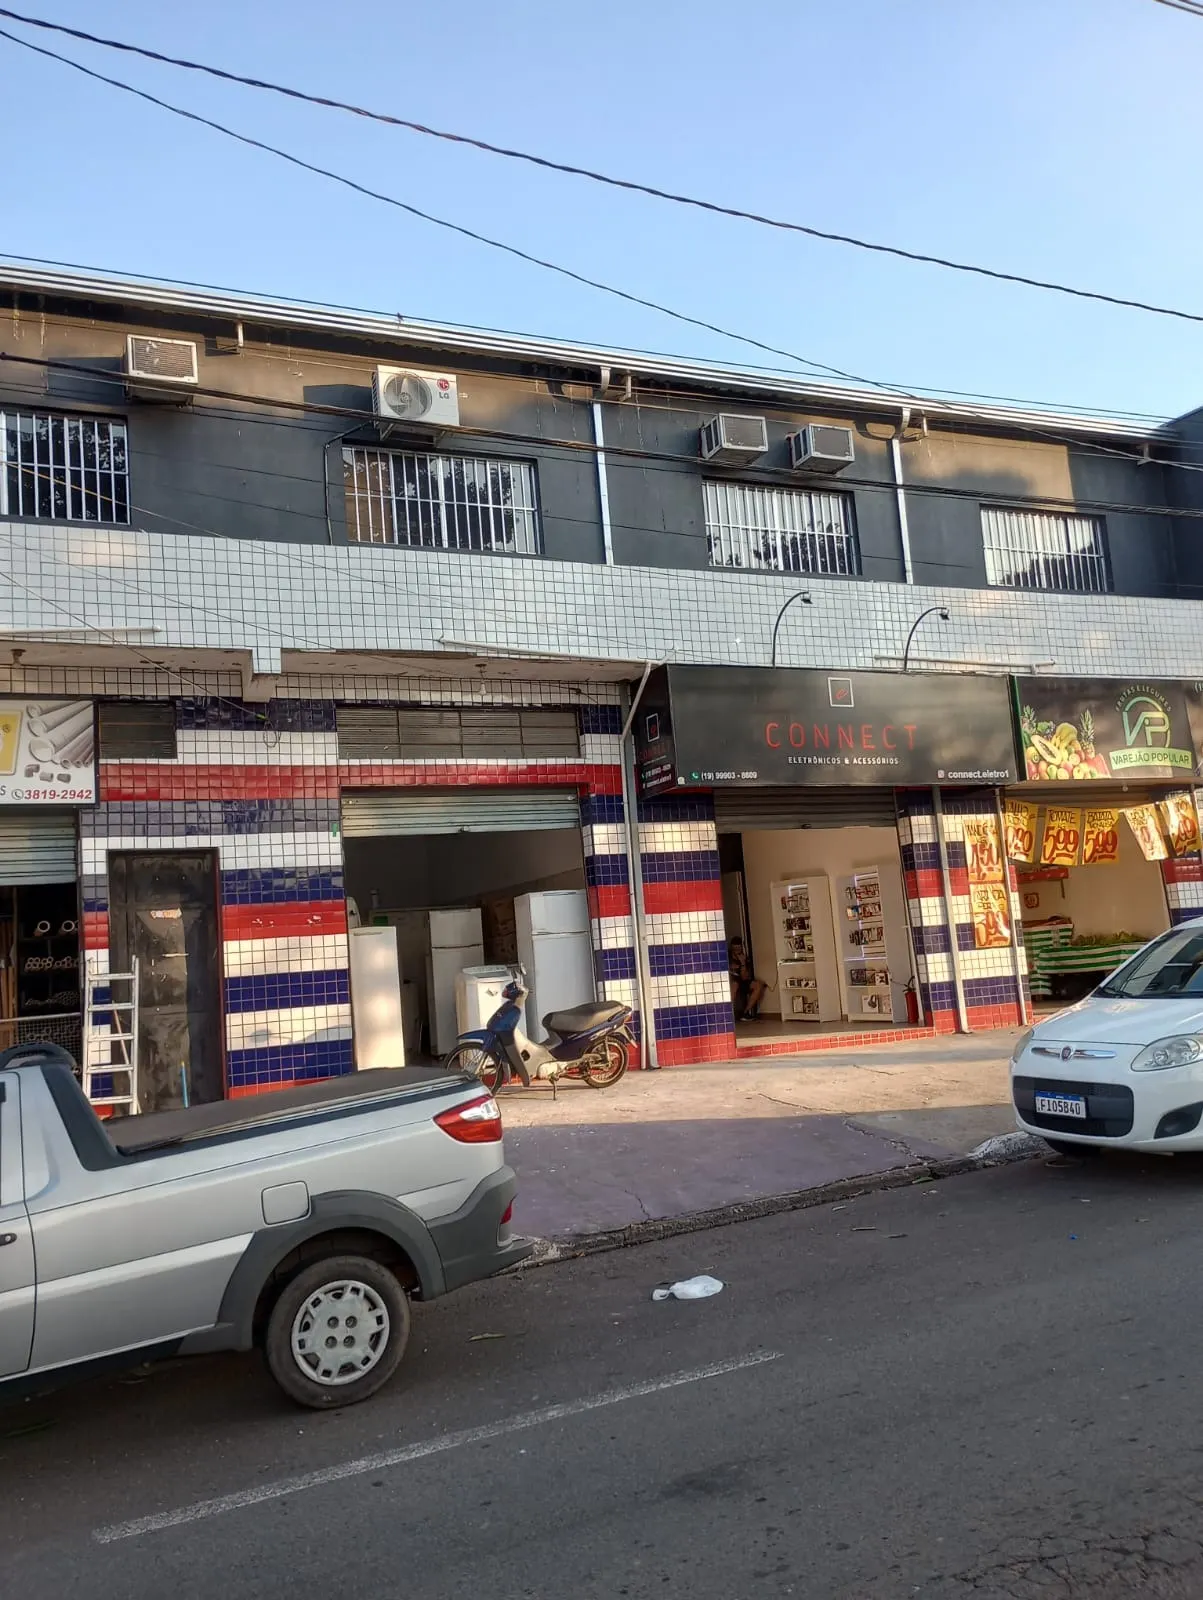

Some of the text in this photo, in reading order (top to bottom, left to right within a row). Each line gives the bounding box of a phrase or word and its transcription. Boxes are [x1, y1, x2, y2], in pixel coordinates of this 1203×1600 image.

[439, 391, 450, 400] LG
[765, 722, 918, 750] CONNECT
[788, 755, 841, 765] ELETRÔNICOS
[853, 756, 899, 765] ACESSÓRIOS
[1112, 752, 1190, 765] VAREJÃO POPULAR
[24, 789, 92, 800] 3819-2942
[1048, 809, 1076, 824] TOMATE
[1043, 826, 1079, 864] 5,99
[1084, 830, 1118, 863] 5,99
